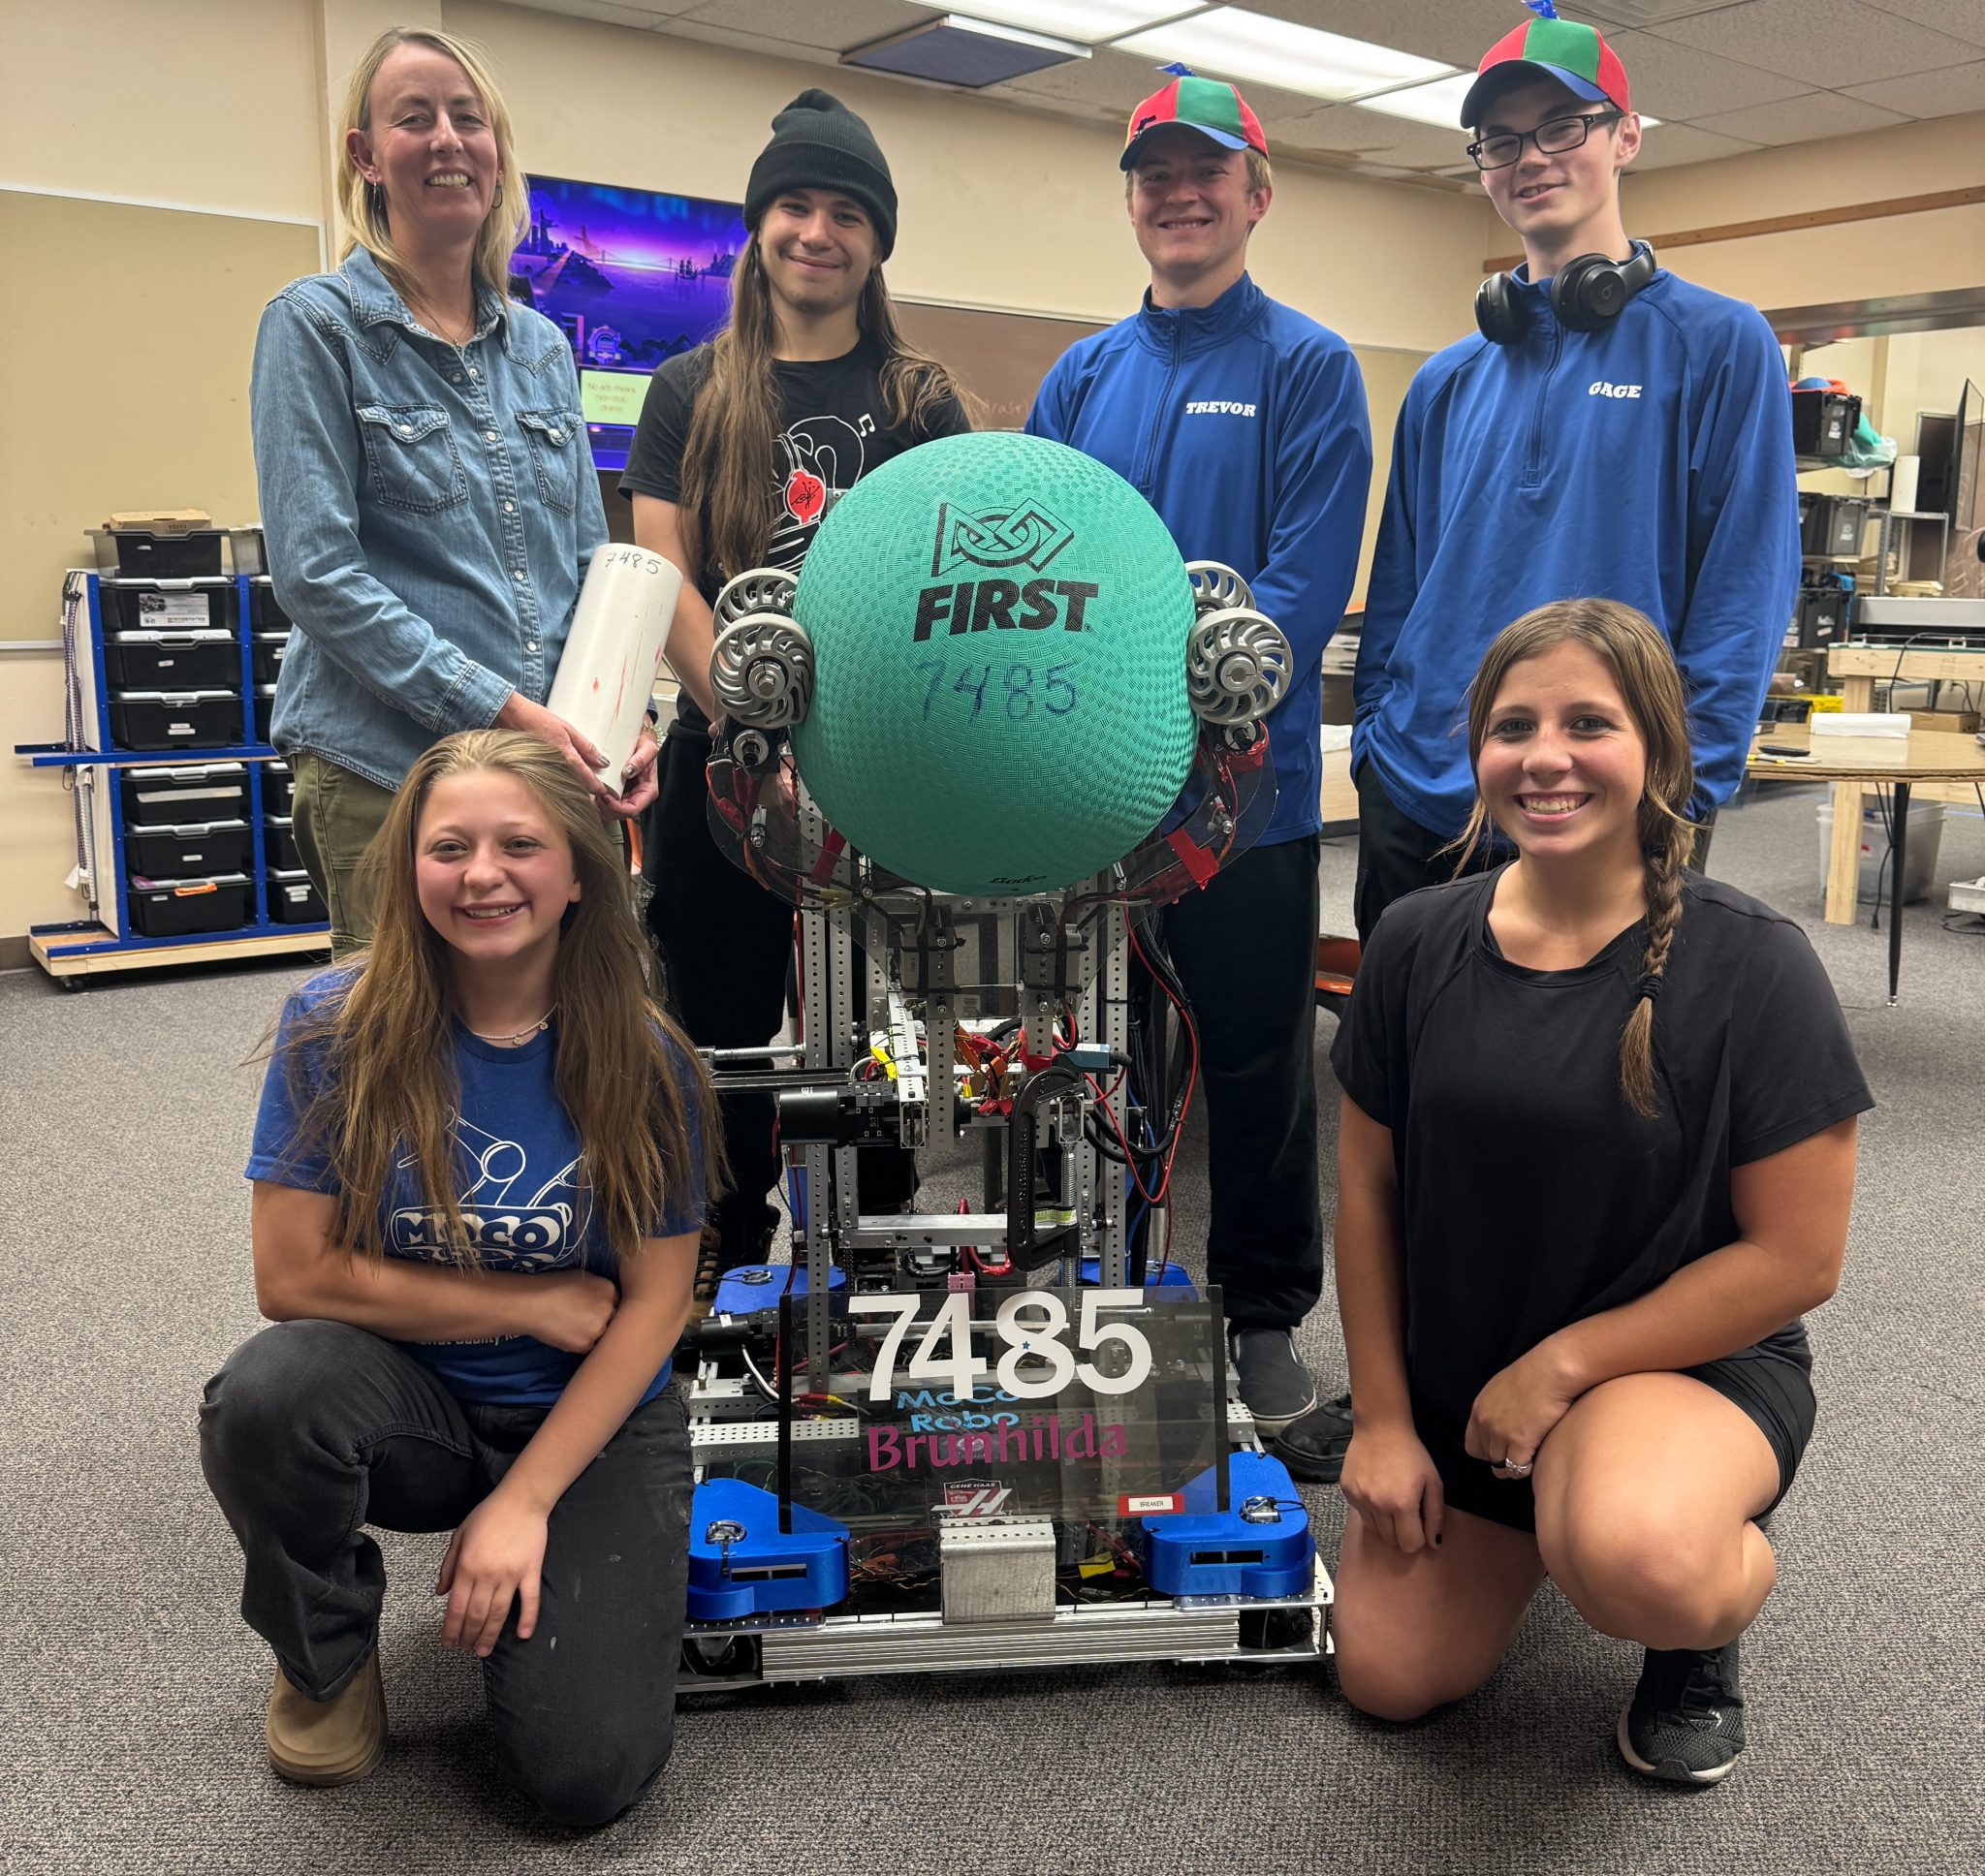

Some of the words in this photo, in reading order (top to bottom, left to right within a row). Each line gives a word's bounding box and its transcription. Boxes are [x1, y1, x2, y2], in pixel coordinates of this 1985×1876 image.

[1185, 401, 1256, 418] TREVOR
[1589, 381, 1643, 398] GAGE
[605, 551, 661, 574] 7485
[913, 578, 1099, 642] FIRST
[915, 659, 1078, 722] 7485
[848, 1289, 1152, 1401] 7485
[911, 1410, 1020, 1433] Robo
[867, 1413, 1128, 1472] Brunhilda
